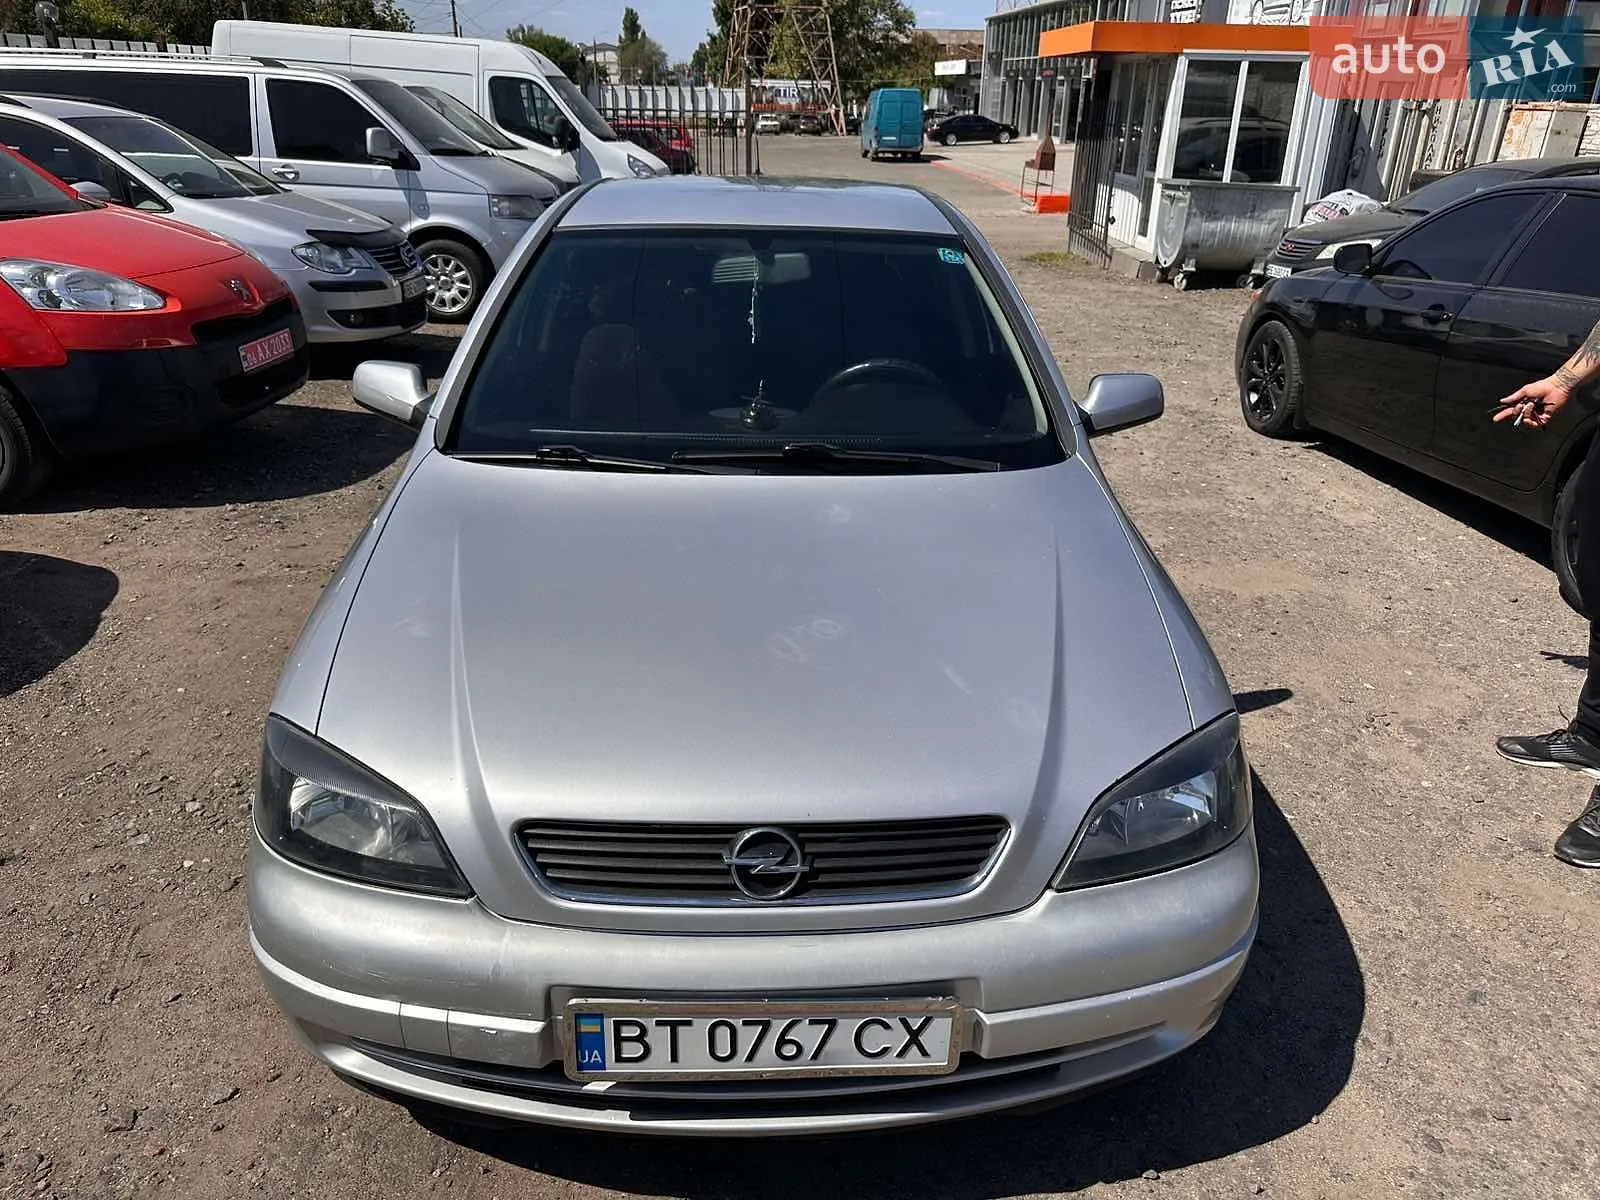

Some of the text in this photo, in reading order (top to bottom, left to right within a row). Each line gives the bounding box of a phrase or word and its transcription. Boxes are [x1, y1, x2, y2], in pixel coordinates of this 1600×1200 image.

[779, 87, 798, 97] TIR
[611, 1015, 935, 1063] BT 0767 CX
[578, 1049, 602, 1063] UA
